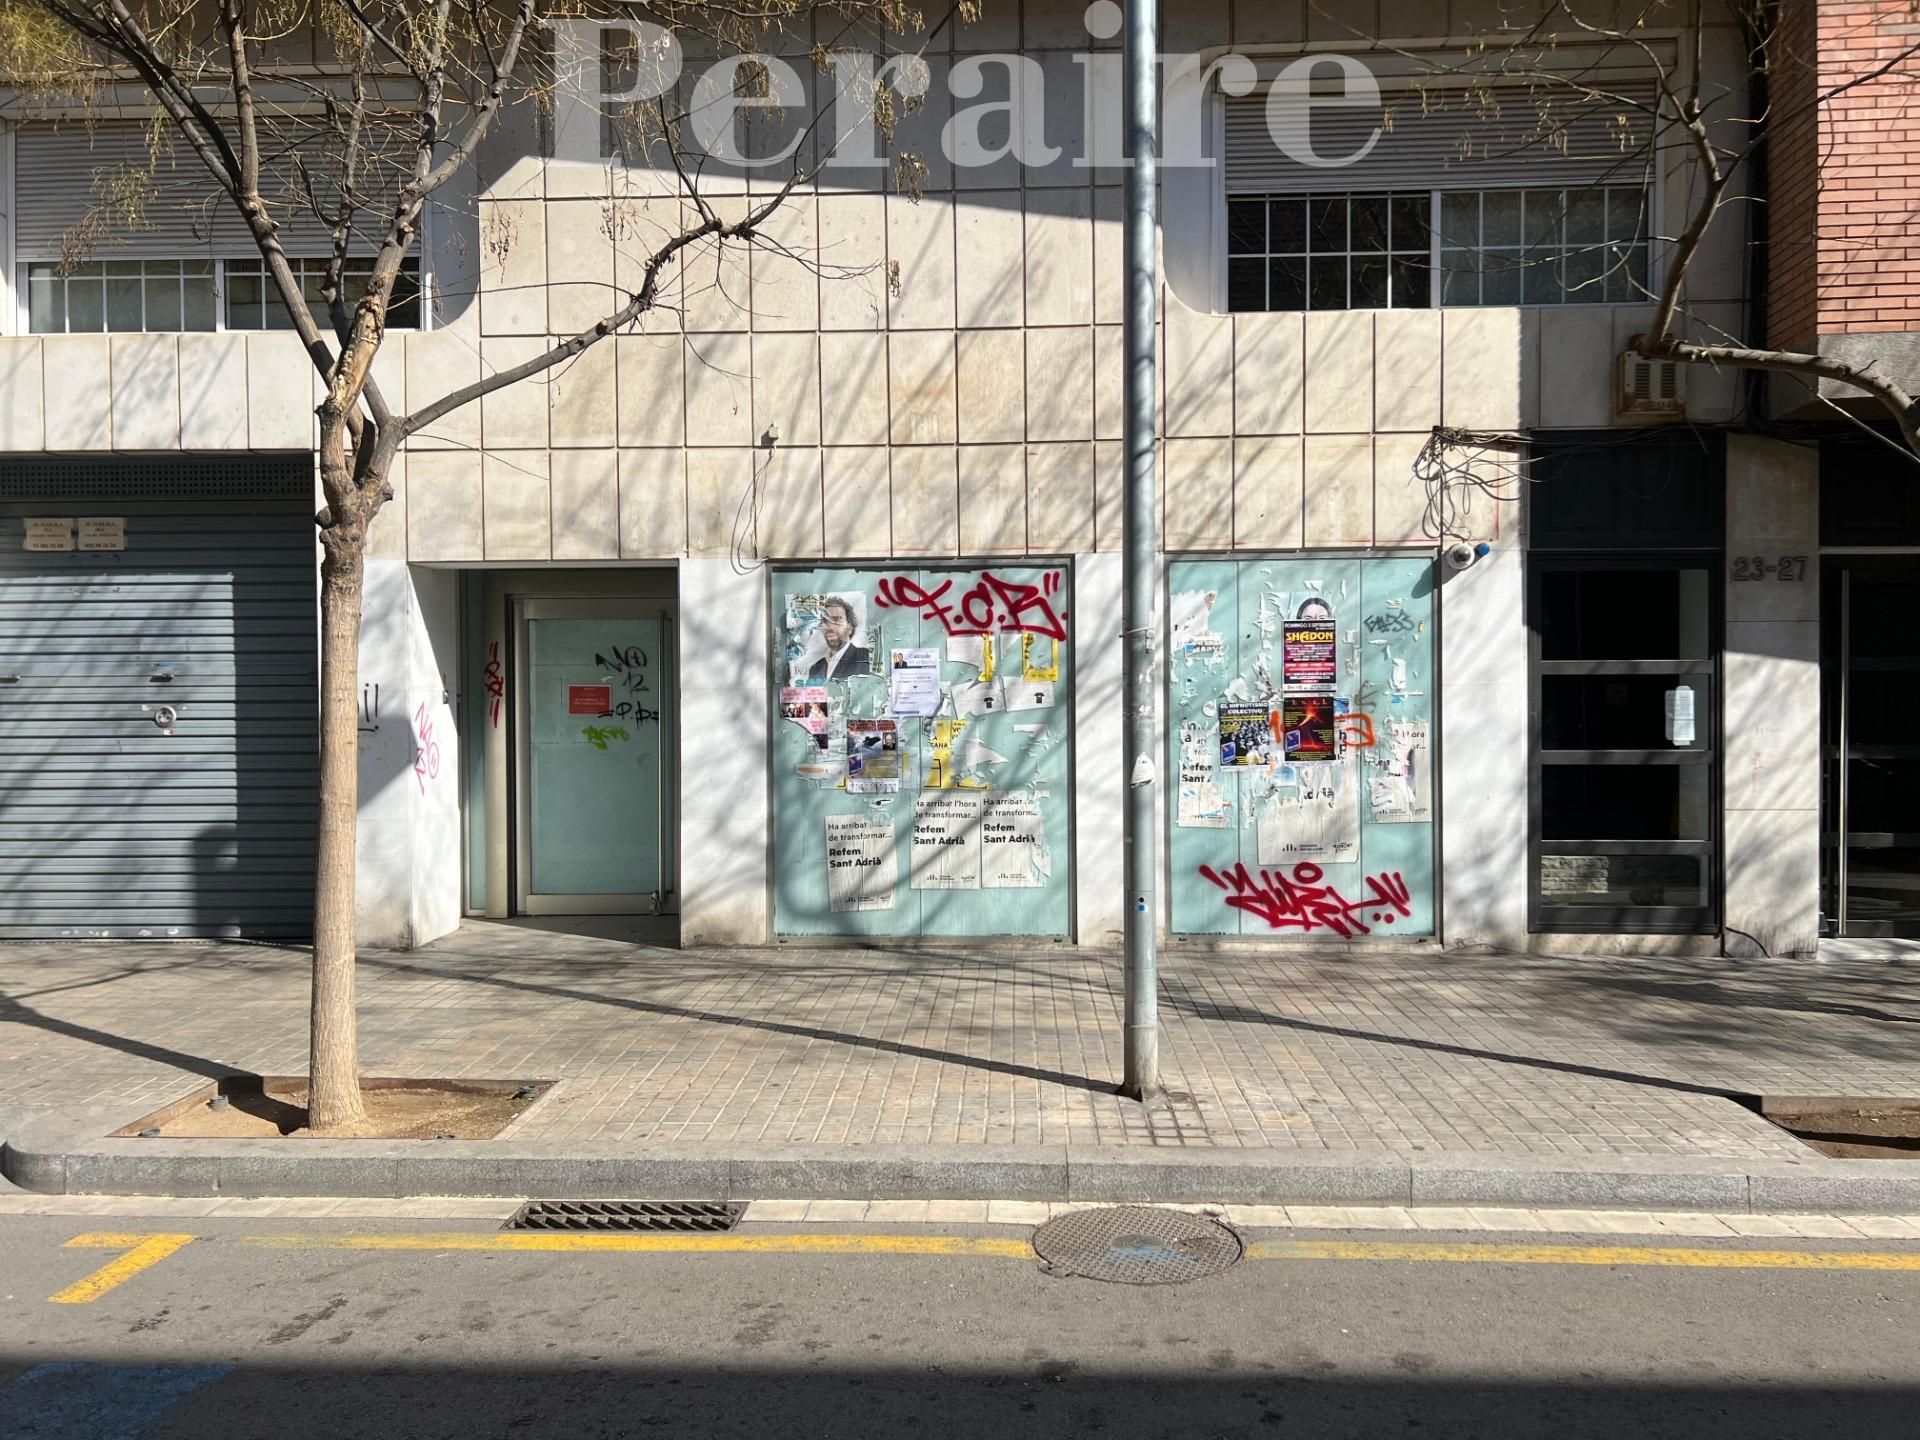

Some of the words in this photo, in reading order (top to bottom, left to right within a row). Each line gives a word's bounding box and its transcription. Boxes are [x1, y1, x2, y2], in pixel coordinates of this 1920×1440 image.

[1733, 556, 1808, 581] 23-27
[954, 800, 977, 808] l'hora
[828, 823, 839, 831] Ha
[841, 822, 867, 830] arribat
[914, 825, 945, 833] Refem
[983, 823, 1015, 832] Refem
[914, 836, 936, 845] Sant
[938, 836, 965, 845] Adrià
[983, 835, 1006, 843] Sant
[829, 848, 862, 857] Refem
[829, 859, 852, 868] Sant
[855, 857, 882, 867] Adrià
